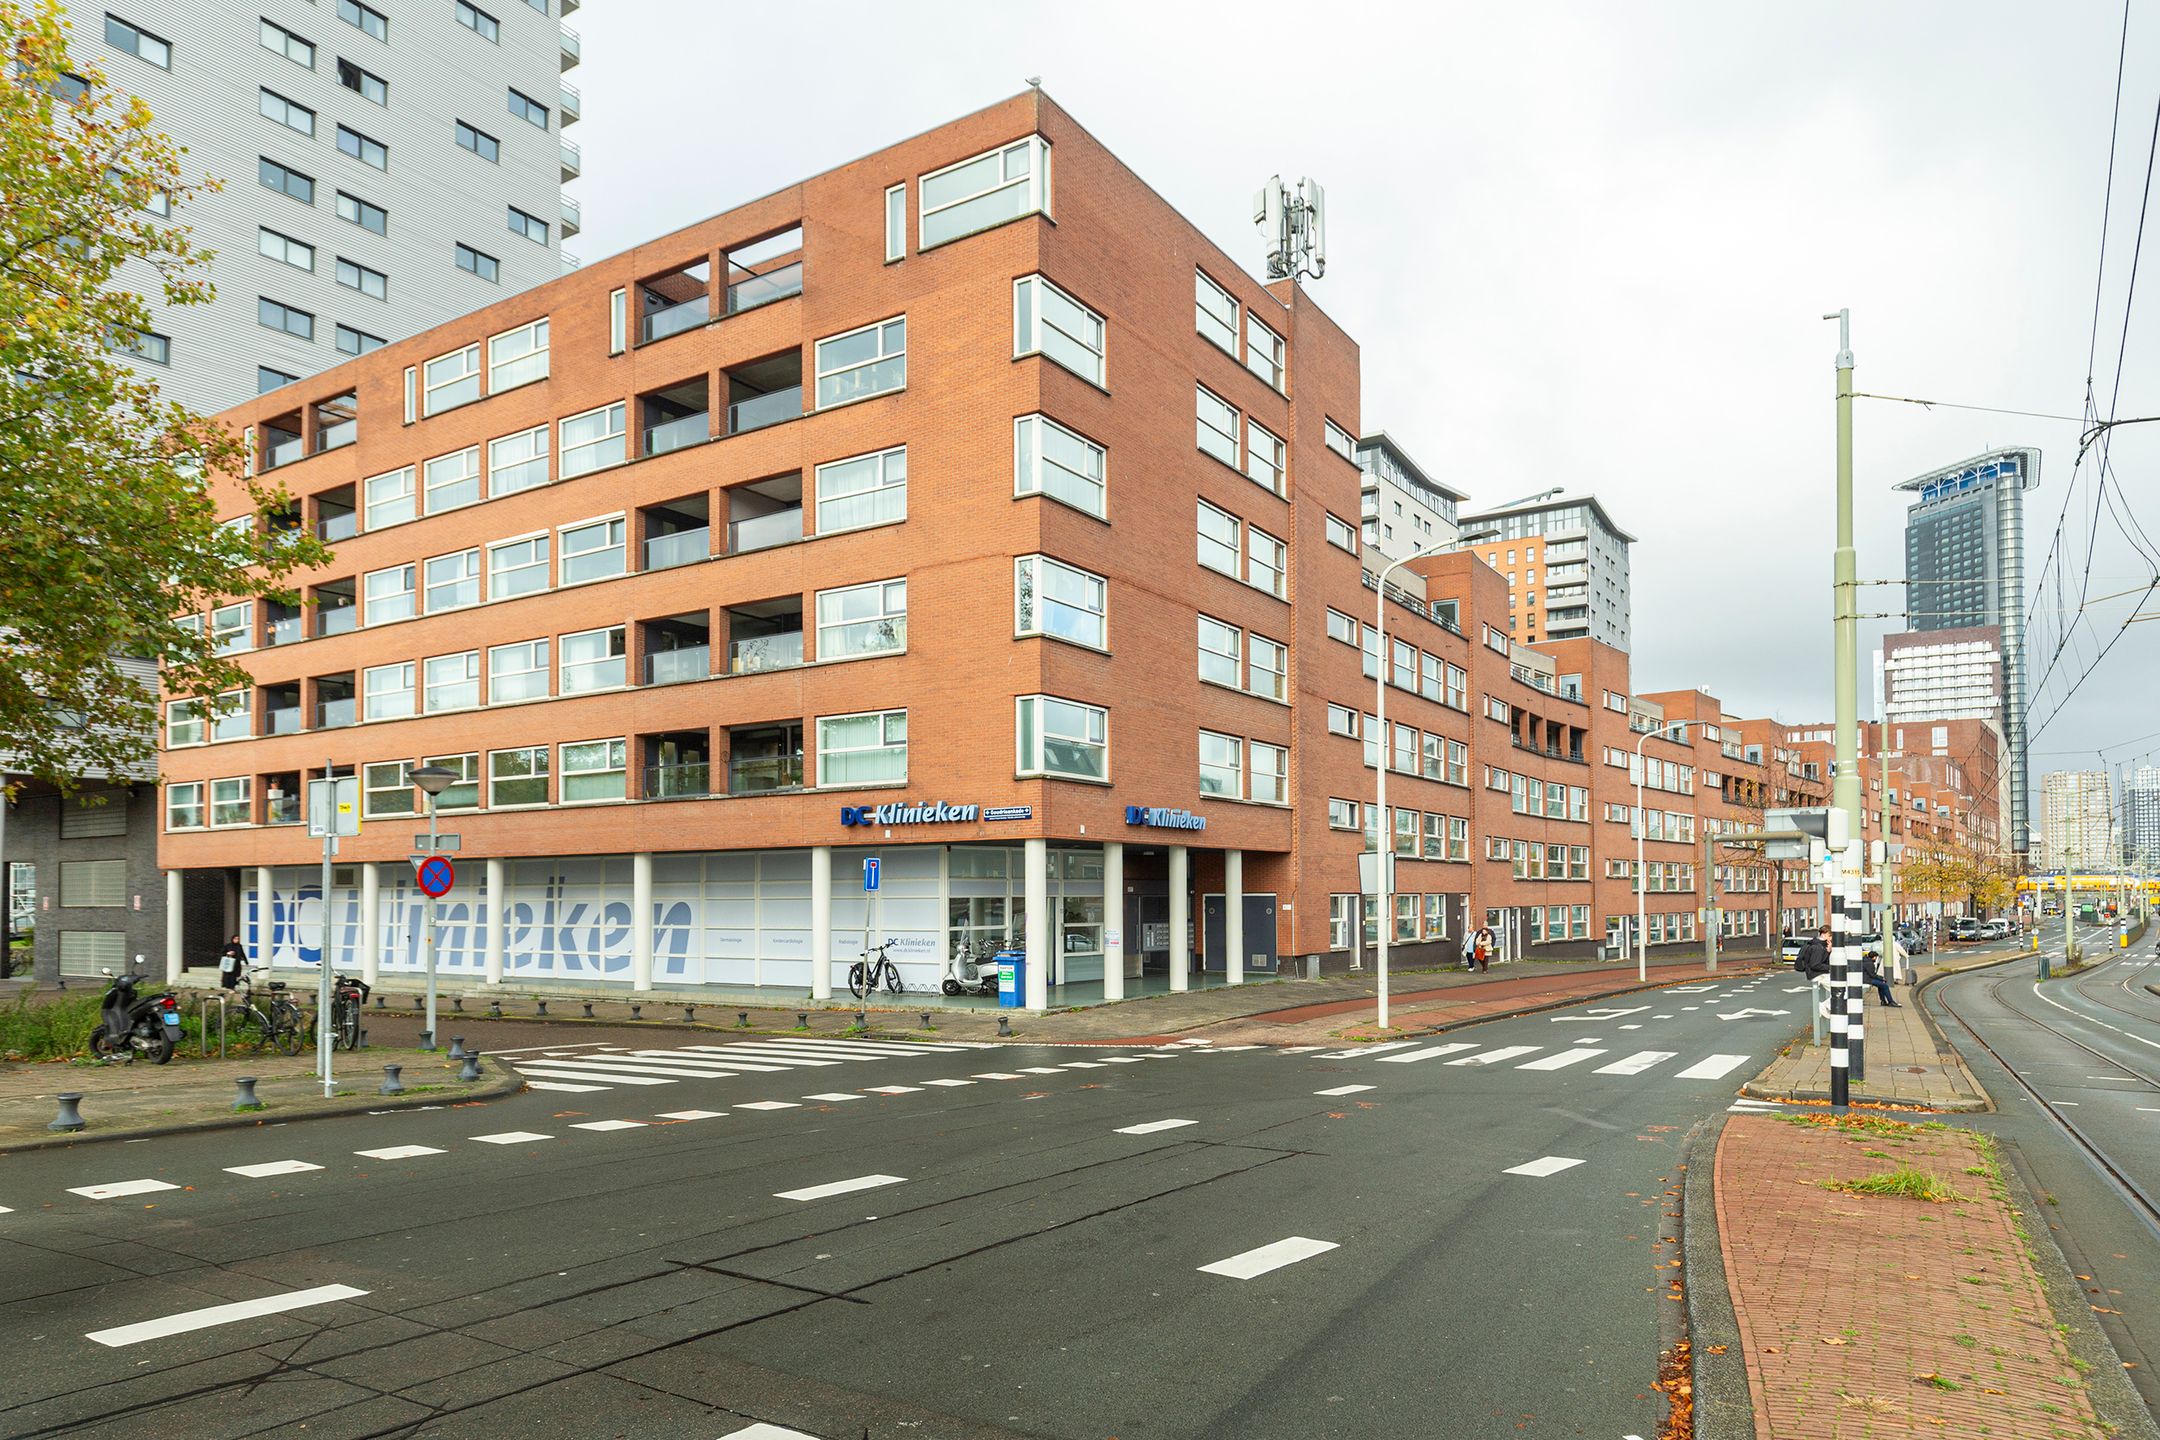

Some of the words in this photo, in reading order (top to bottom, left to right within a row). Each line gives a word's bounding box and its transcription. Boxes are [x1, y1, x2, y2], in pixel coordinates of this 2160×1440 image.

[841, 806, 872, 825] DC
[874, 800, 979, 825] Klinieken
[1126, 806, 1150, 825] DC
[1151, 807, 1207, 830] Klinieken
[248, 884, 323, 963] DC
[887, 938, 899, 946] DC
[900, 937, 936, 947] Klinieken
